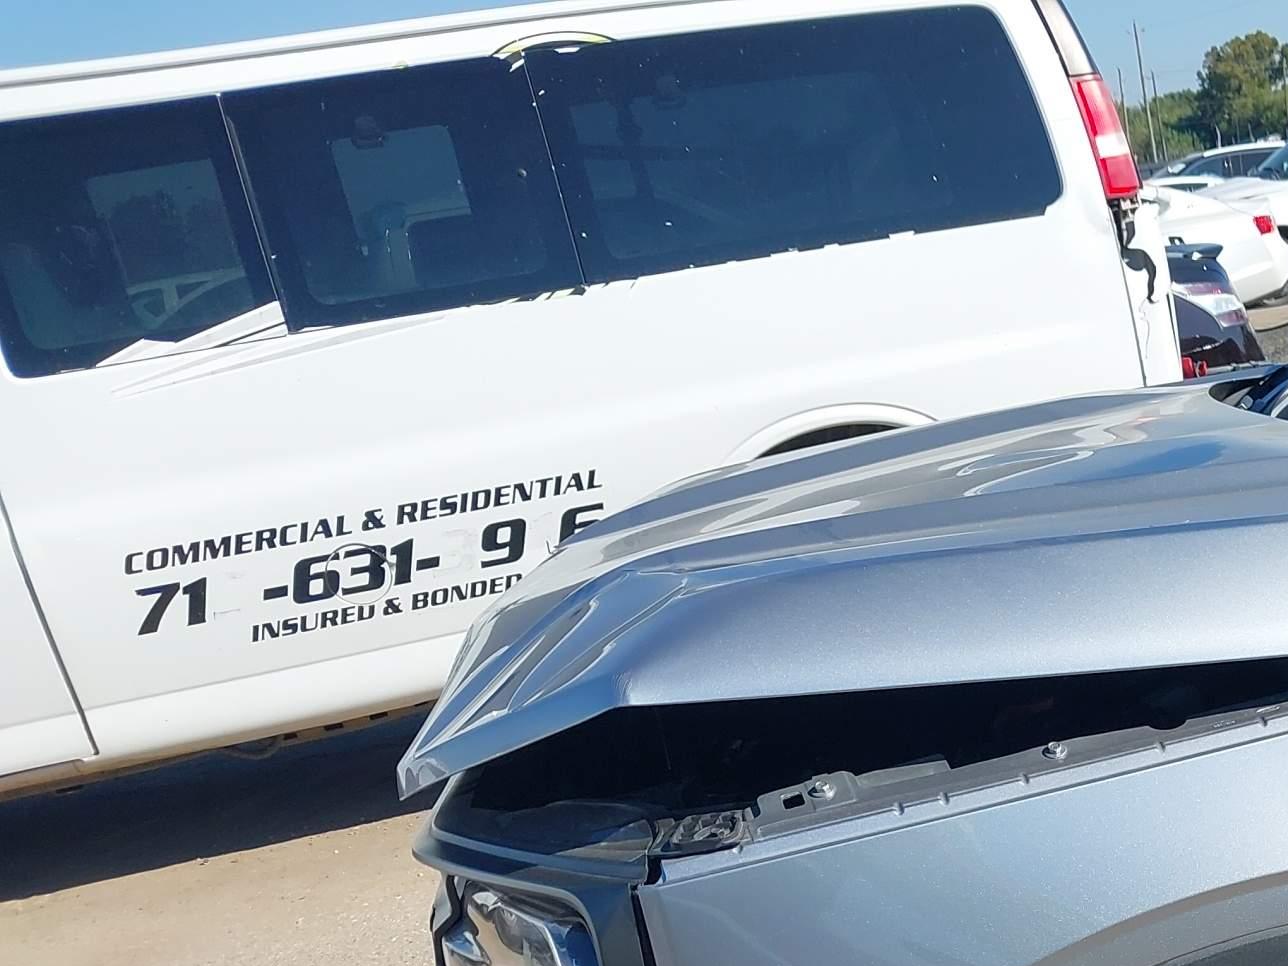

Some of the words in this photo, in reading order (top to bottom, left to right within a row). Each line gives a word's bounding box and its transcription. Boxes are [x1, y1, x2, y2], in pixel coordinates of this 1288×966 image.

[125, 515, 353, 575] COMMERCIAL
[361, 508, 386, 532] &
[396, 469, 602, 525] RESIDENTIAL
[252, 604, 375, 643] INSURED
[383, 597, 403, 616] &
